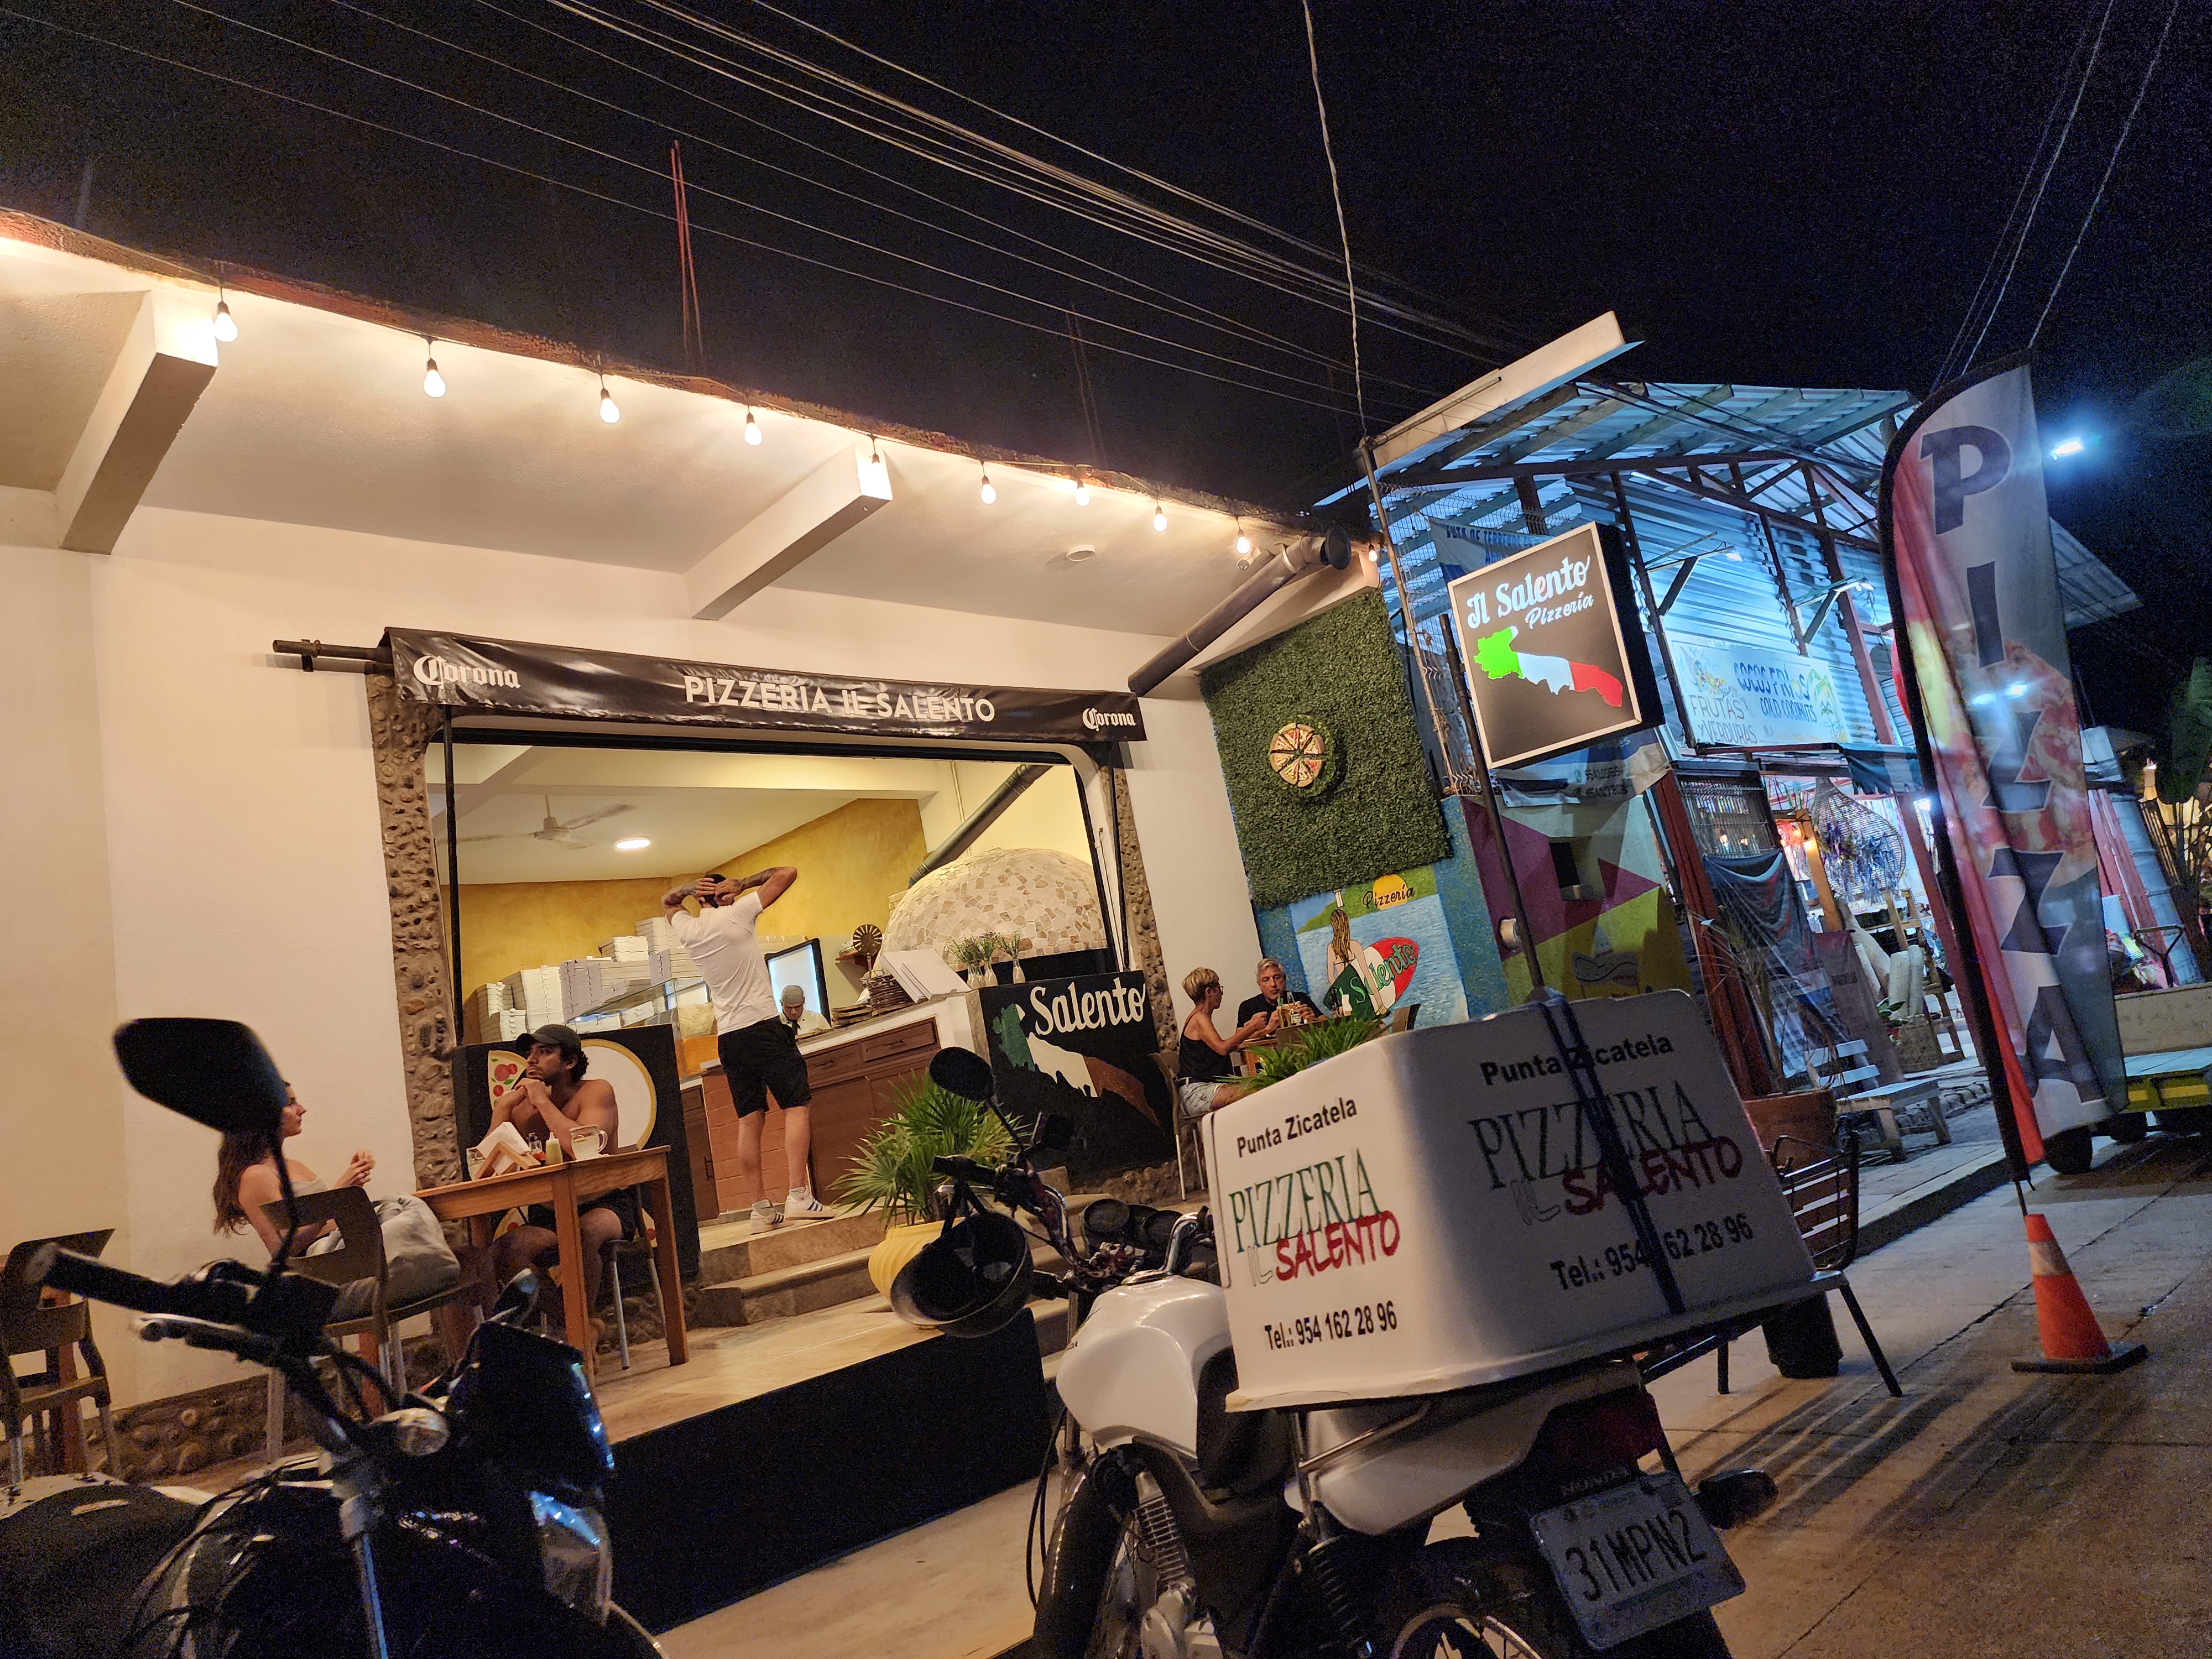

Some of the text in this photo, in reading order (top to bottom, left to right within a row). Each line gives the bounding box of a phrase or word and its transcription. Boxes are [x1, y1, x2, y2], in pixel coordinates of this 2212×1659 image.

[1495, 555, 1590, 618] Salento
[414, 655, 521, 690] Corona
[1734, 662, 1771, 695] COCOS
[684, 675, 995, 722] PIZZERIA IL SALENTO
[1082, 707, 1136, 732] Corona
[1689, 695, 1745, 720] FRUTAS
[1760, 697, 1817, 723] COLD COCONUTS
[1702, 720, 1757, 744] VERDURAS
[1920, 425, 2106, 1103] PIZZA
[1030, 977, 1146, 1036] Salento
[1481, 1034, 1674, 1086] Punta Zcatela
[1237, 1098, 1357, 1157] Punta Zicatela
[1468, 1080, 1713, 1190] PIZZRIA
[1229, 1148, 1384, 1253] PIZZERIA
[1275, 1210, 1400, 1281] SALENTO
[1694, 1221, 1724, 1251] 28
[1724, 1213, 1754, 1243] 96
[1296, 1314, 1322, 1345] 954
[1326, 1309, 1352, 1340] 162
[1355, 1305, 1374, 1334] 28
[1378, 1300, 1397, 1331] 96
[1565, 1509, 1708, 1601] 31MPN2
